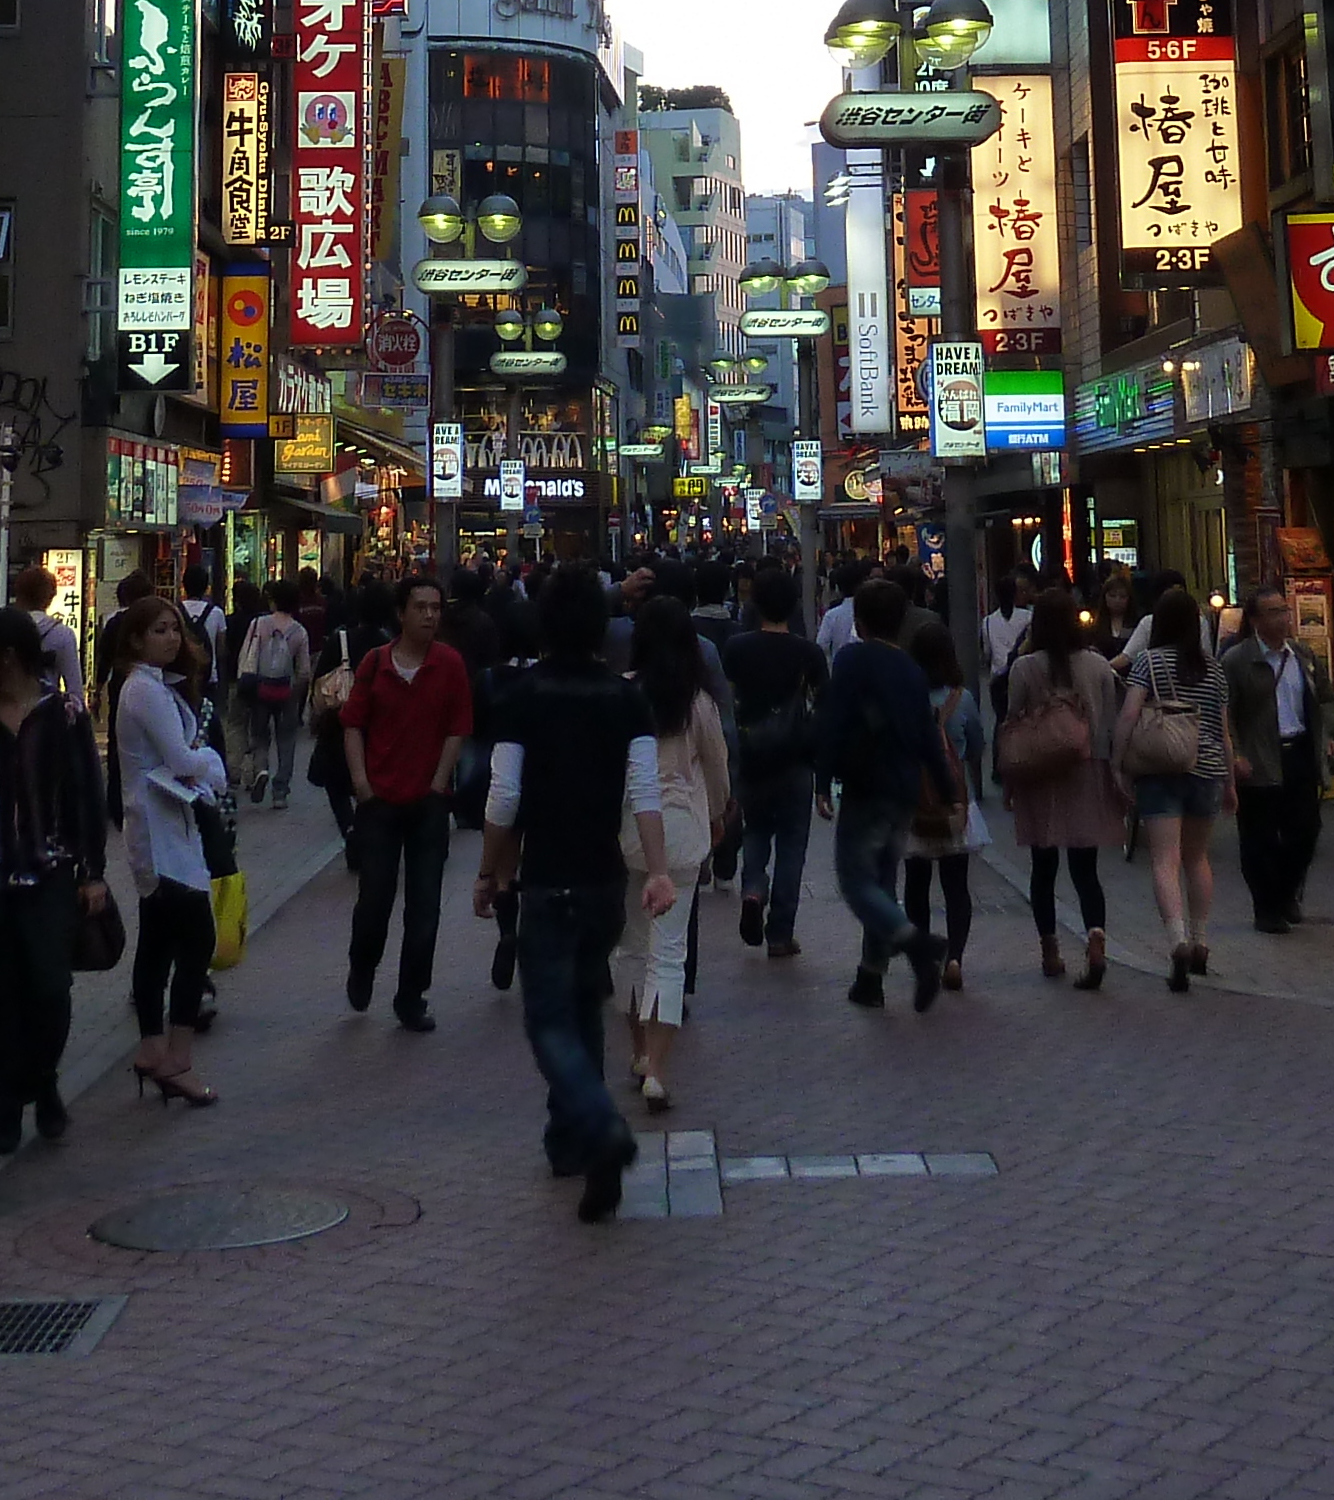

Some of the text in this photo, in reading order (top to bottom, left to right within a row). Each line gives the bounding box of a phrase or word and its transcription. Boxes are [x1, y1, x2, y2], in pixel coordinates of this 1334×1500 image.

[835, 104, 992, 126] 渋谷センター街
[1012, 81, 1033, 173] ケーキと
[1199, 73, 1236, 190] 珈琲と甘味
[1130, 85, 1196, 214] 椿屋
[257, 81, 270, 240] Gyu-Syoku Dining
[225, 108, 253, 241] 牛角食堂
[270, 227, 291, 239] 2F
[1147, 221, 1219, 238] つばきや
[298, 167, 355, 330] 歌広場
[989, 191, 1044, 299] 椿屋
[124, 274, 187, 285] レモンステーキ
[418, 268, 517, 282] 渋谷センター街
[124, 292, 185, 304] ねぎ塩焼き
[983, 305, 1053, 322] つばきや
[744, 316, 825, 330] 渋谷センター街
[129, 333, 180, 352] B1F
[378, 333, 417, 352] 消火栓
[936, 347, 970, 360] HAVE
[495, 357, 561, 368] 渋谷センター街
[857, 324, 880, 417] SoftBank
[936, 362, 981, 375] DREAM!
[228, 337, 262, 411] 松屋
[941, 400, 980, 421] 福岡
[997, 400, 1059, 414] FamilyMart
[275, 421, 291, 434] 1F
[1008, 433, 1049, 444] 銀行ATM
[798, 471, 818, 483] 大分
